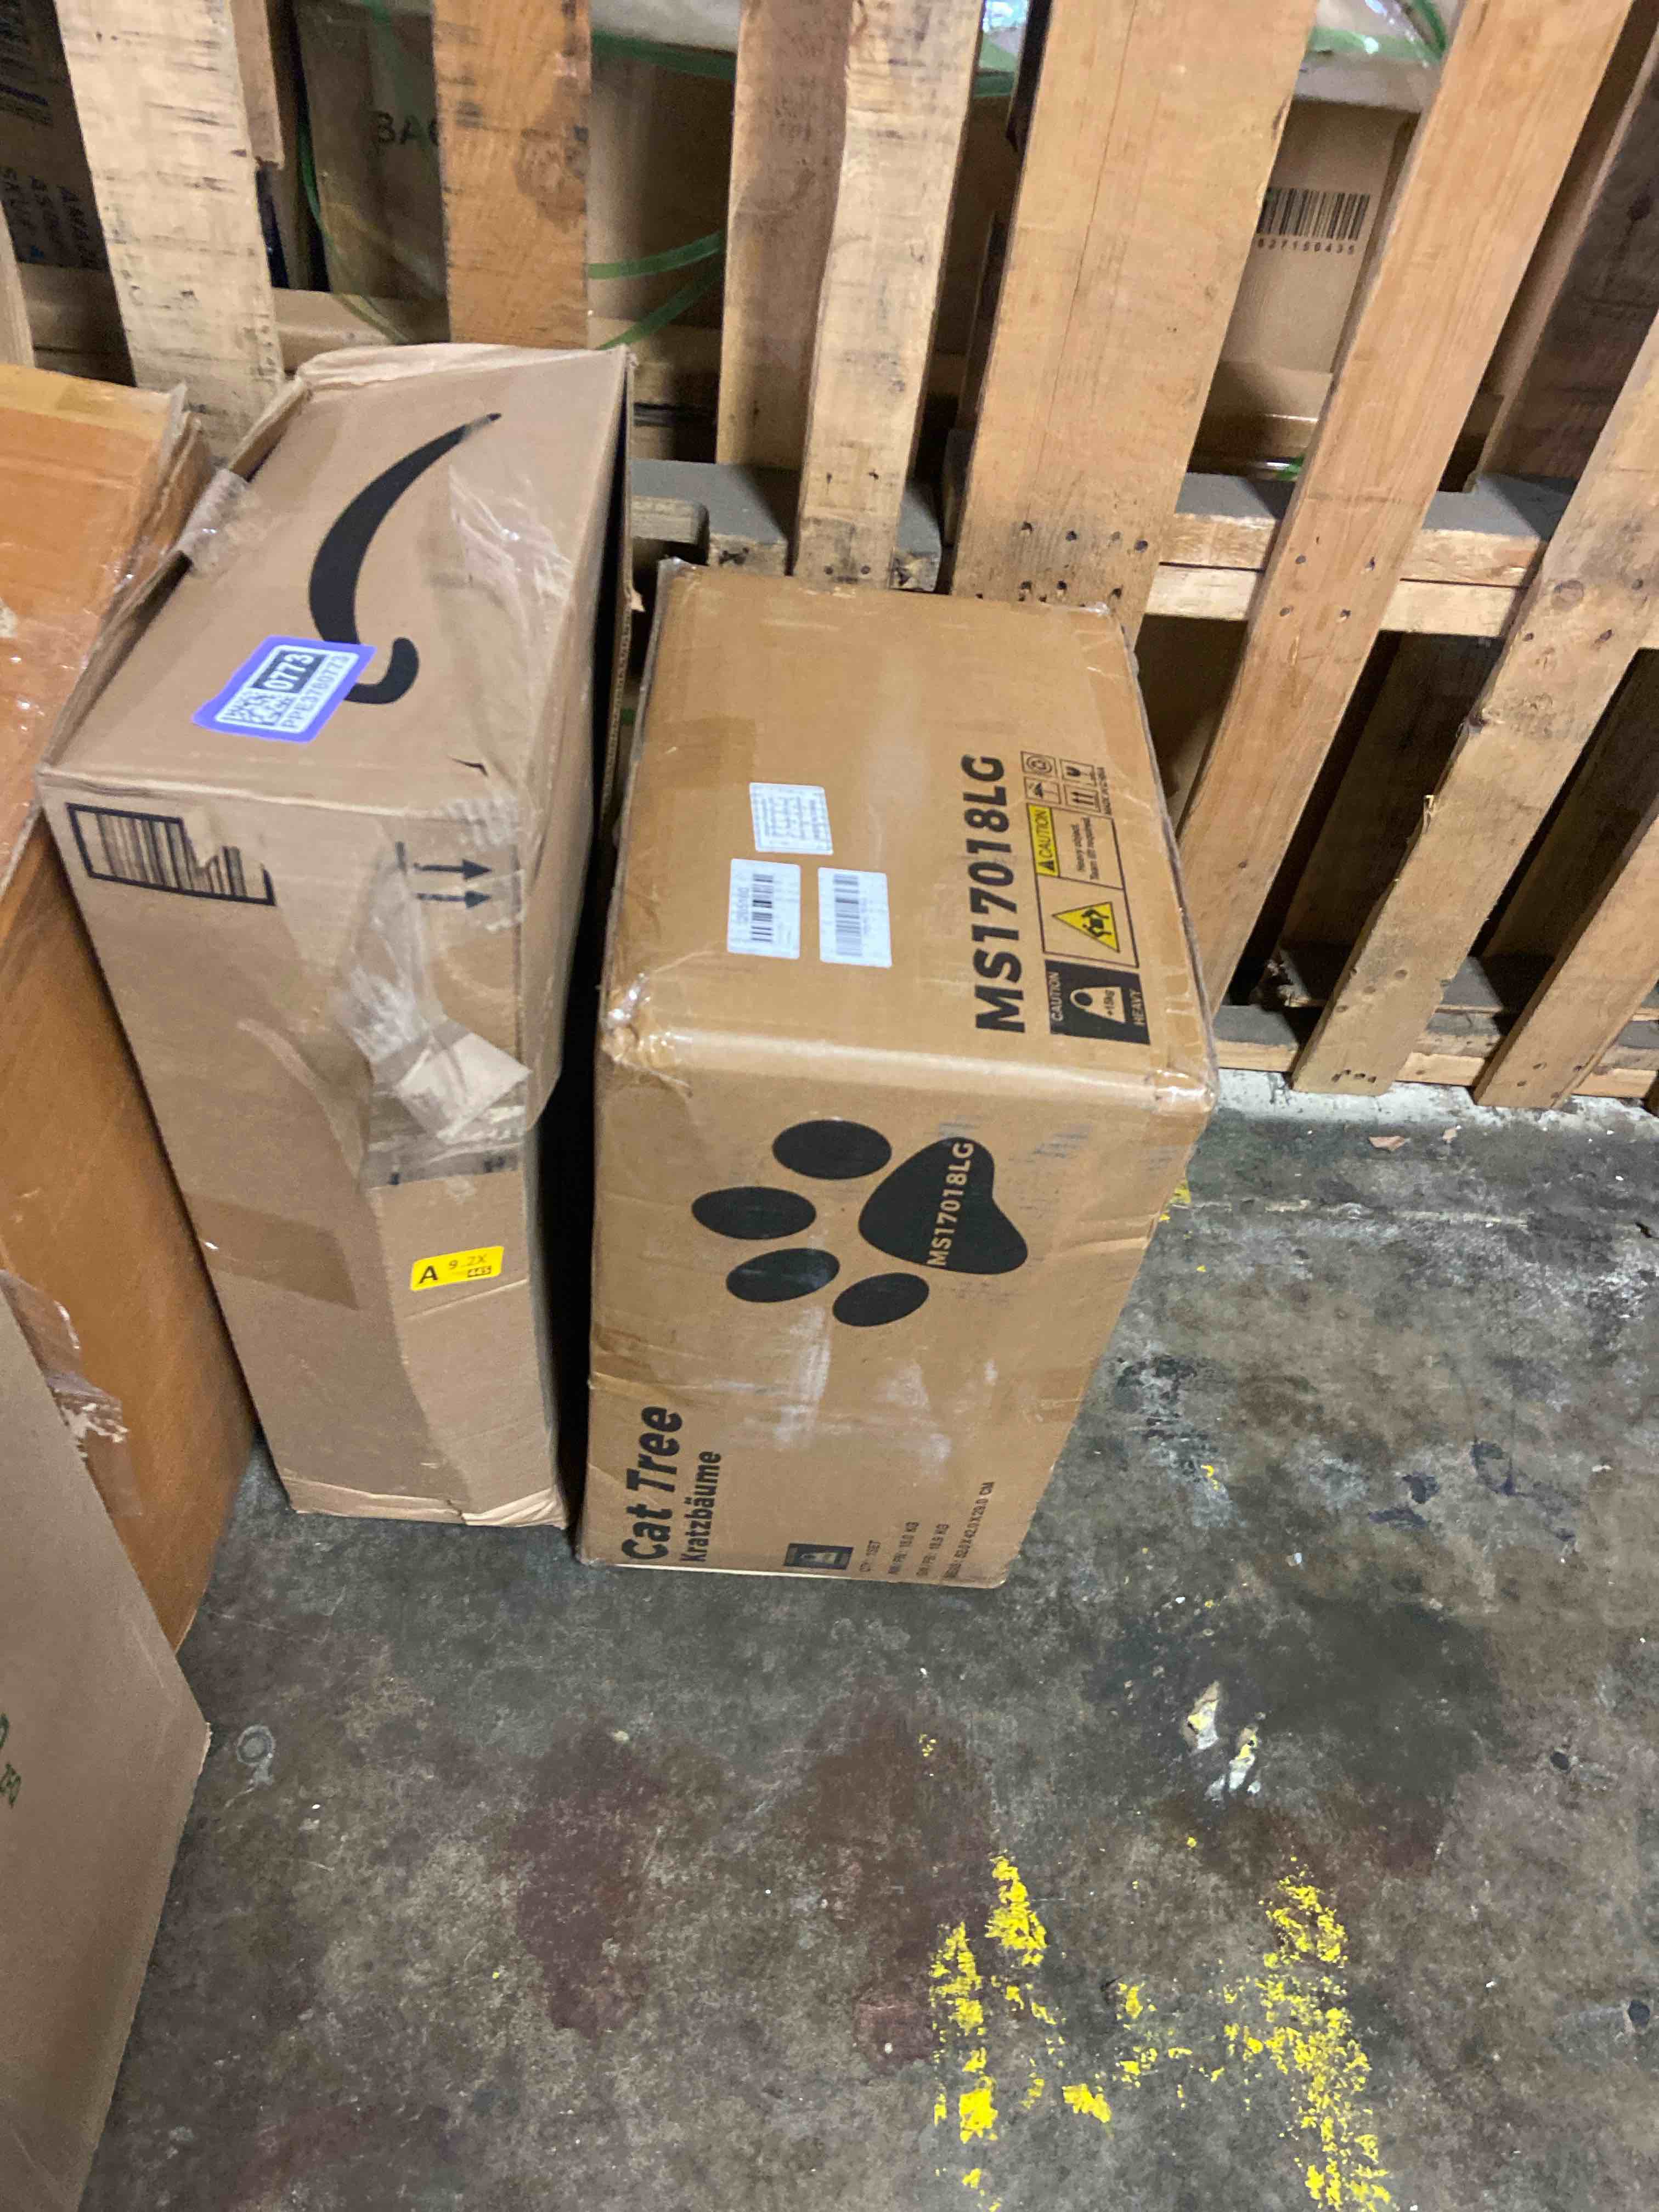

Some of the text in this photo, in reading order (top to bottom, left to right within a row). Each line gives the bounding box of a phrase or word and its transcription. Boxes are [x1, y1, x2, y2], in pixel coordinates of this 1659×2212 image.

[263, 653, 314, 690] 0773
[1035, 809, 1053, 859] CAUTION
[961, 754, 1025, 1034] MS17018LG
[1048, 971, 1064, 1022] CAUTION
[1128, 988, 1147, 1027] HEAVY
[926, 1141, 975, 1267] MS17018LG
[418, 1265, 439, 1284] A
[621, 1406, 683, 1560] Cat Tree
[679, 1451, 722, 1563] Kratzbäume
